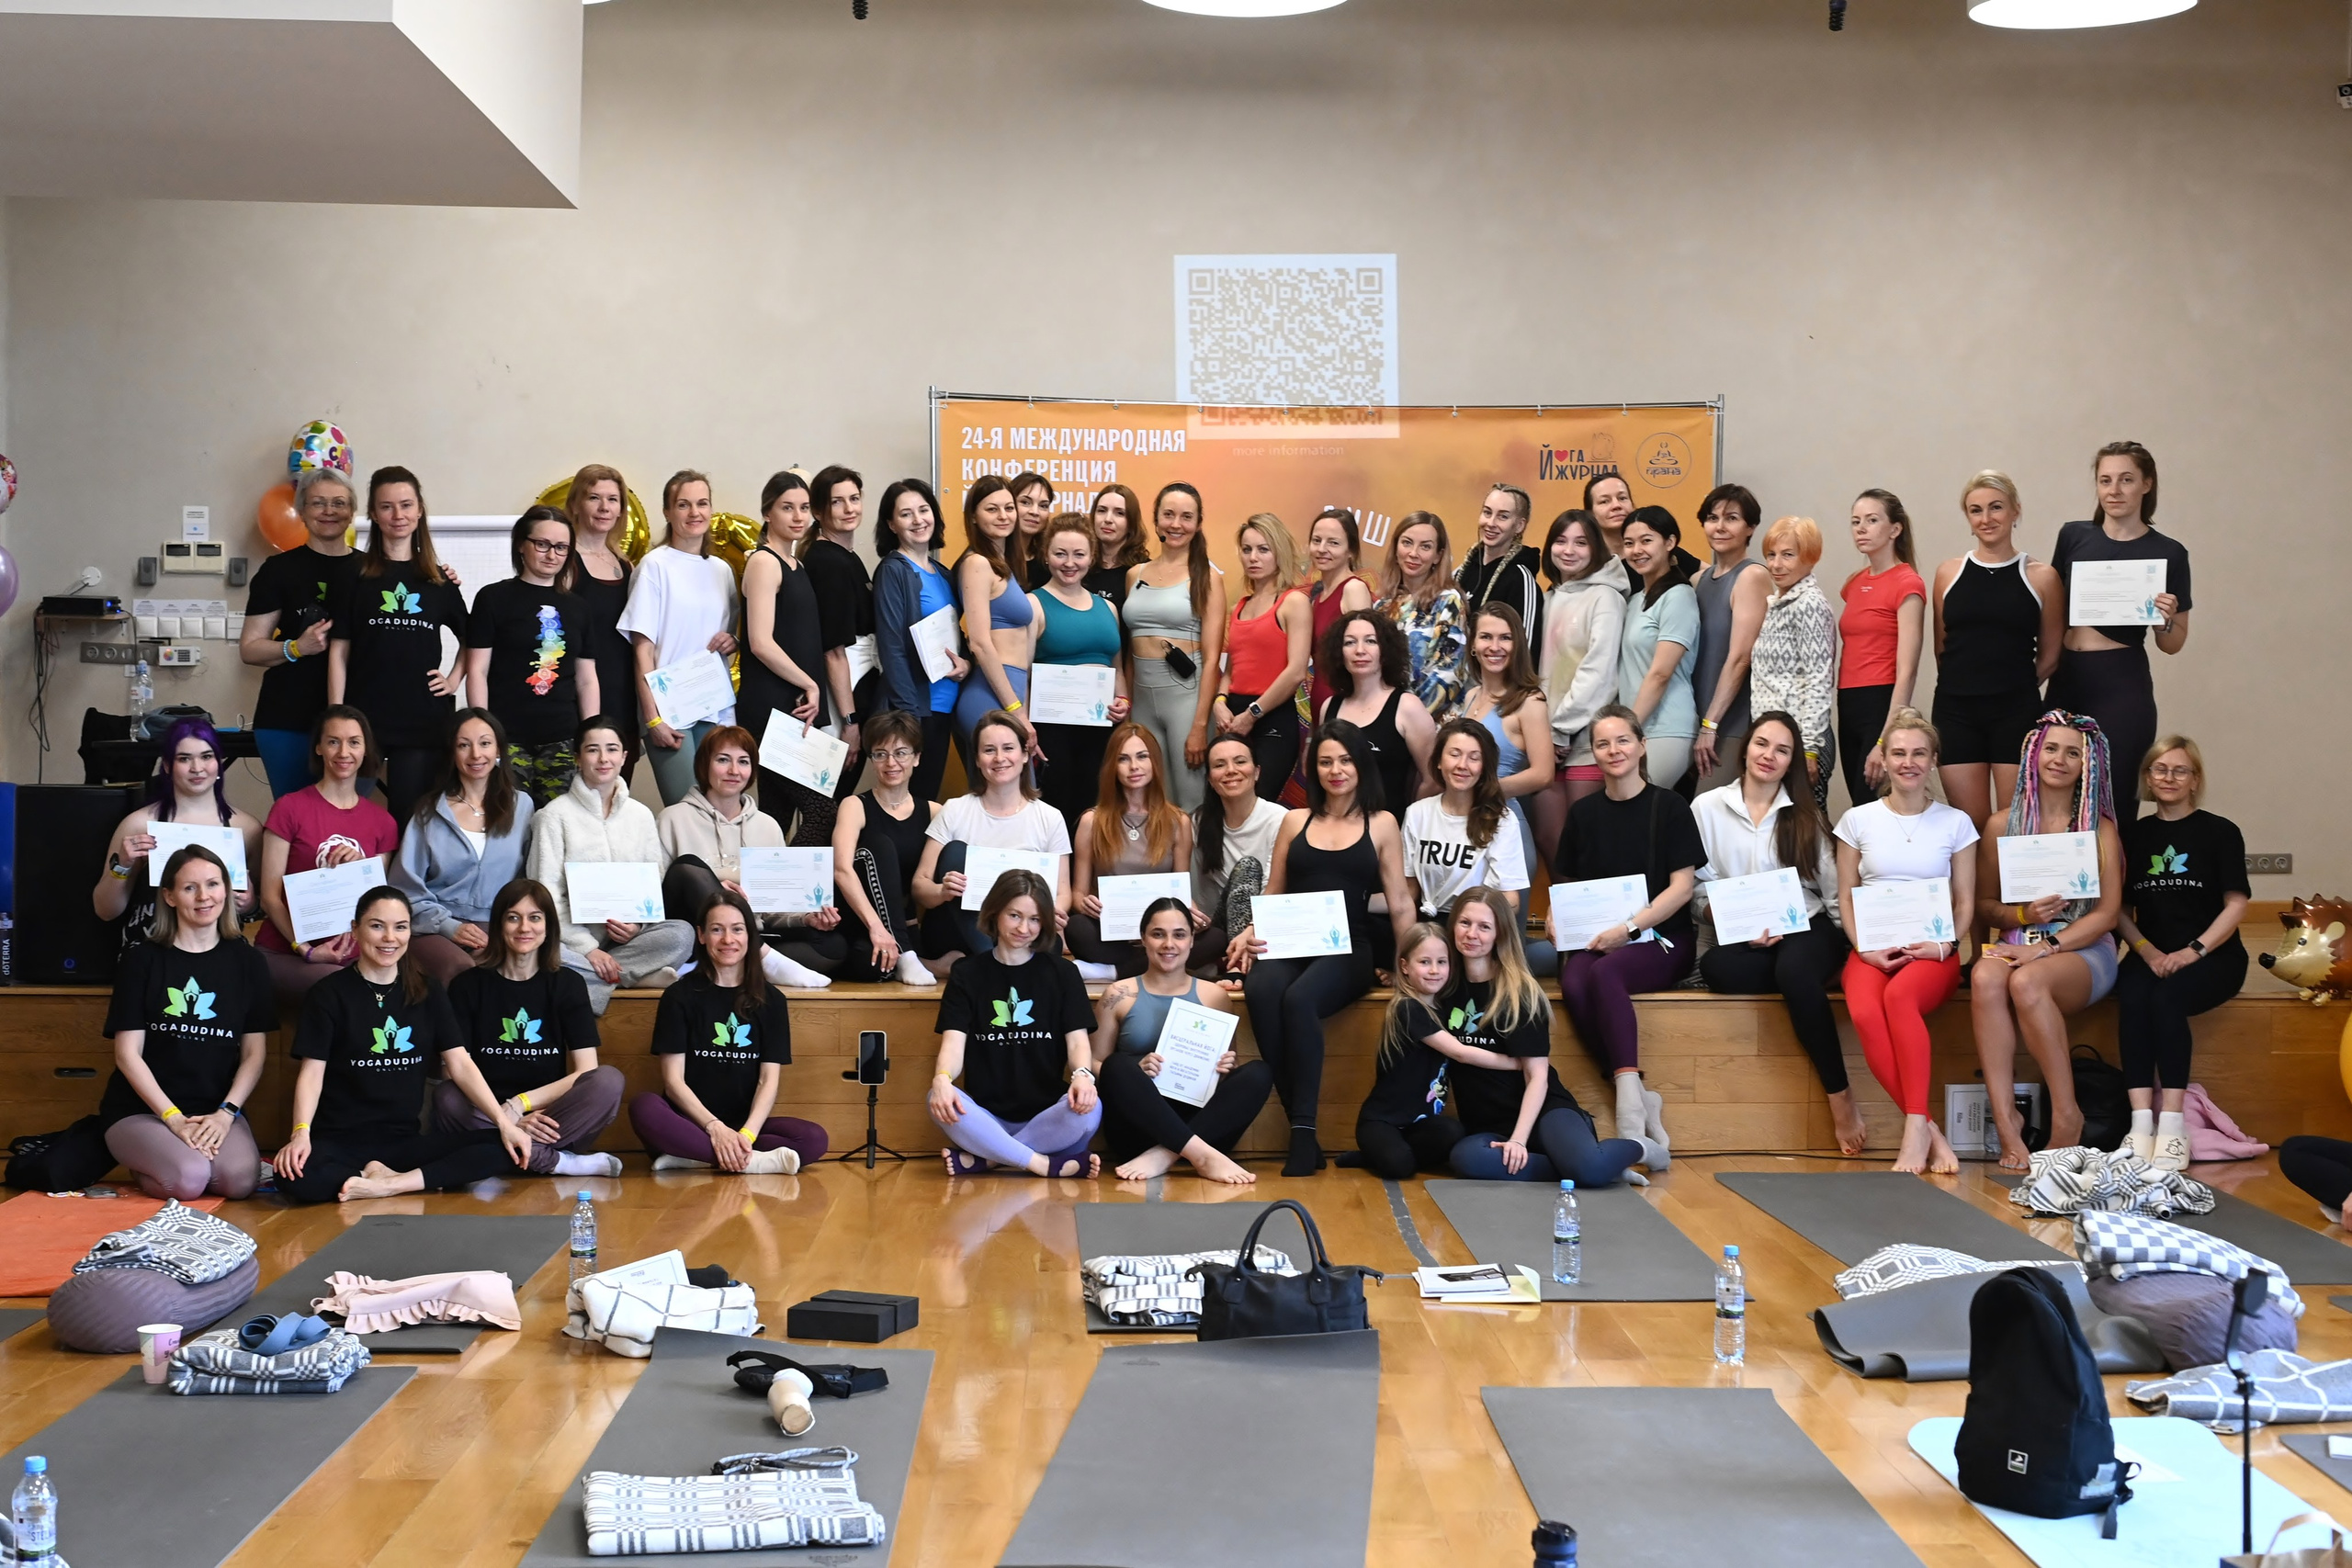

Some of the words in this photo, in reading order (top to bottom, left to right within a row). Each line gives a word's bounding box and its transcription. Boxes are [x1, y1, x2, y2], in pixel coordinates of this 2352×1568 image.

[961, 426, 1003, 449] 24-Я
[1010, 427, 1186, 456] МЕЖДУНАРОДНАЯ
[1232, 446, 1265, 457] more
[1269, 444, 1345, 457] information
[961, 458, 1117, 487] КОНФЕРЕНЦИЯ
[1419, 840, 1476, 870] TRUE
